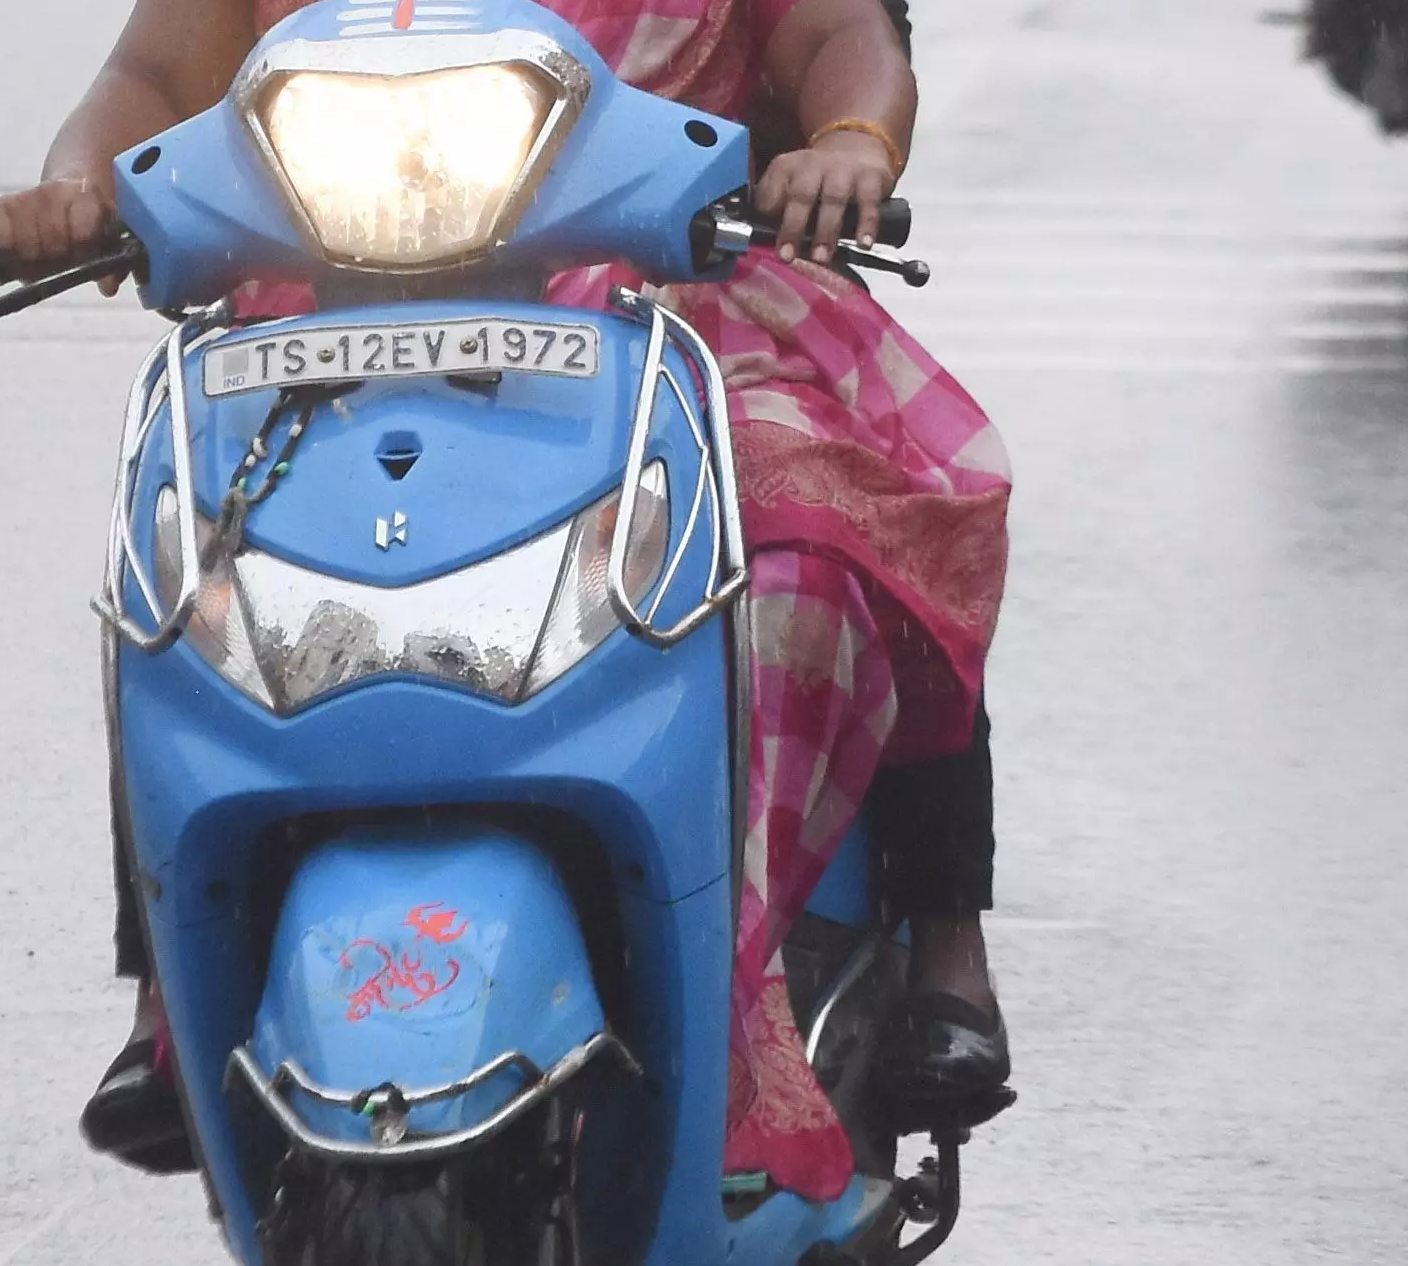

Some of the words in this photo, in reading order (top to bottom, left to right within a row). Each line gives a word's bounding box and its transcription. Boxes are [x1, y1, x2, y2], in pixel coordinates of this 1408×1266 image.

[254, 338, 307, 380] TS
[337, 329, 446, 373] 12EV
[476, 326, 587, 369] 1972
[223, 375, 246, 389] IND
